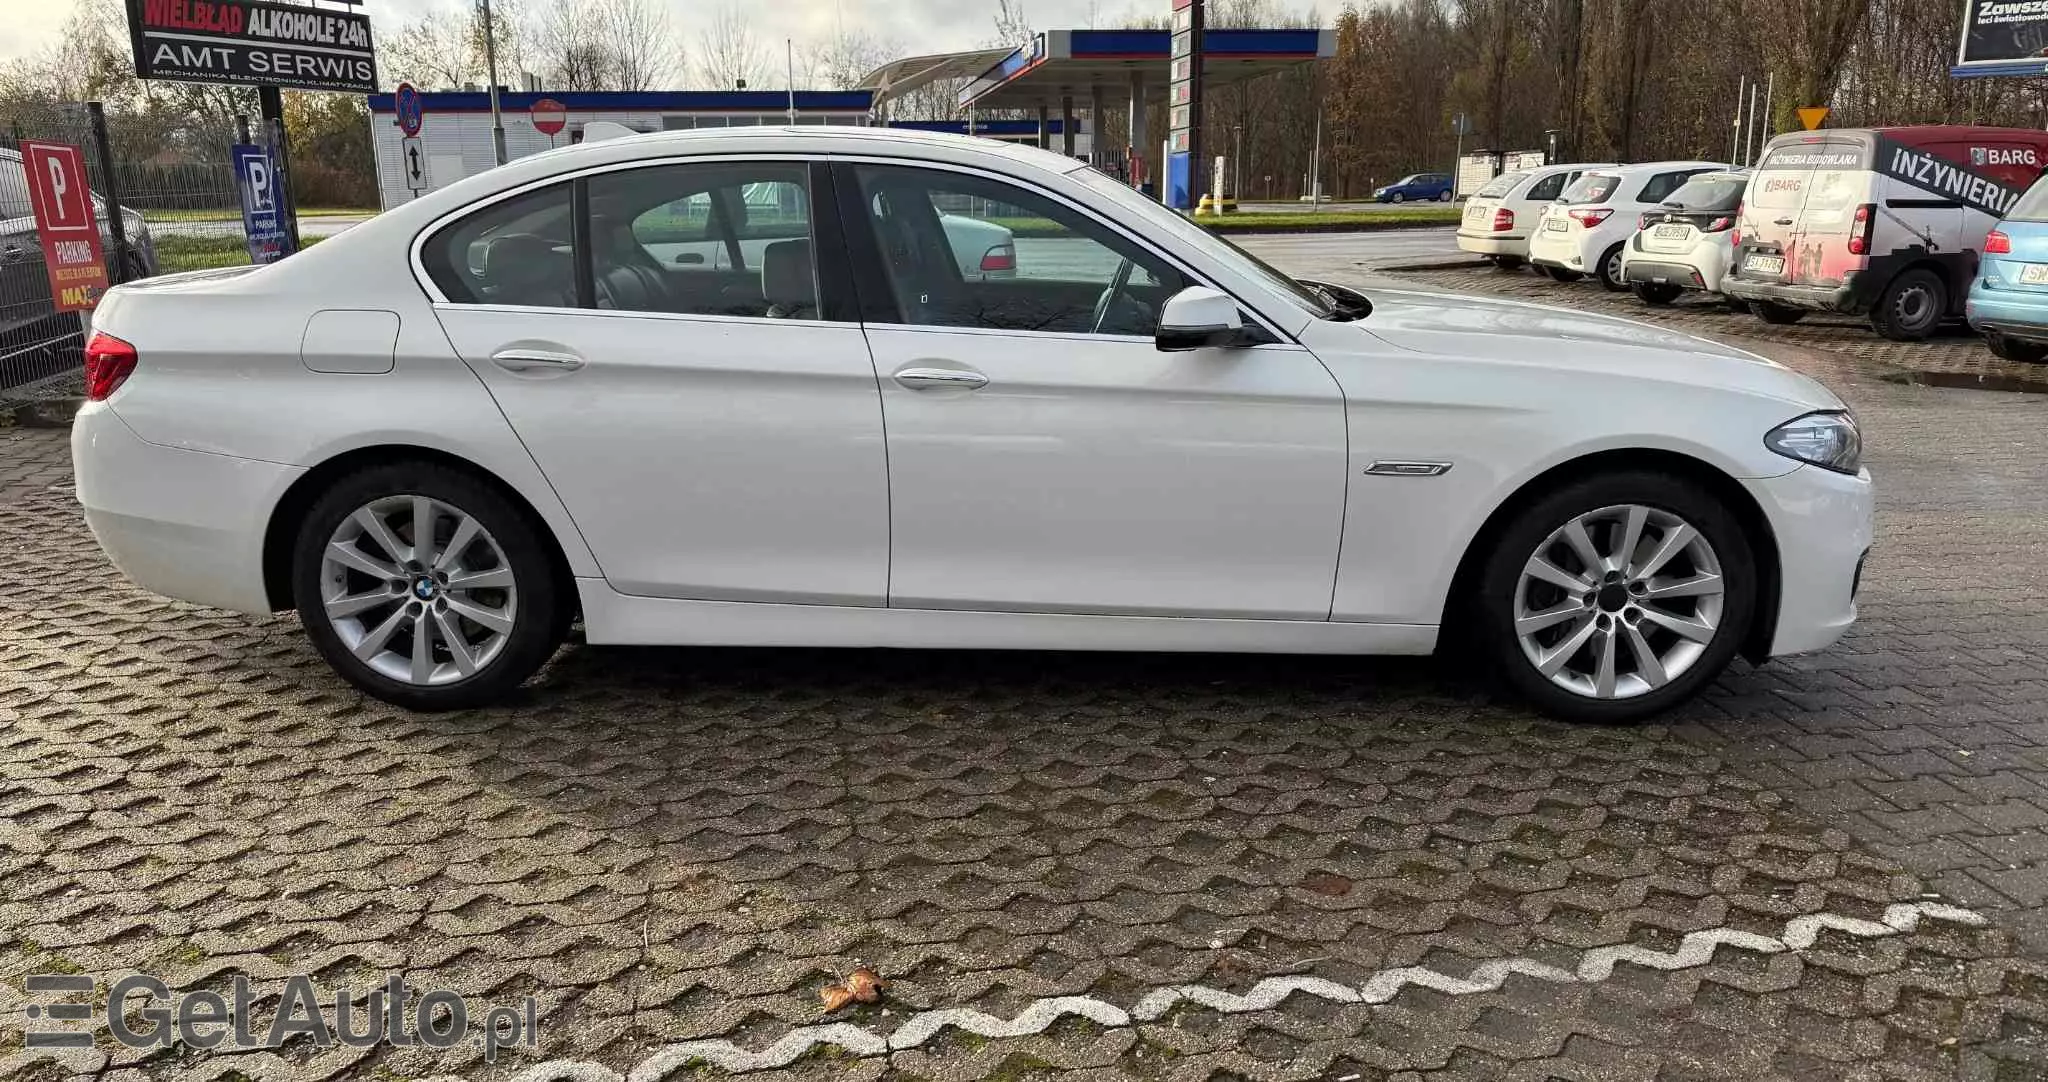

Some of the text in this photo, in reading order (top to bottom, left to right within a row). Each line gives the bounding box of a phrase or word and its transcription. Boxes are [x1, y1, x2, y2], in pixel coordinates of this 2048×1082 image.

[247, 8, 336, 44] ALKOHOLE
[337, 18, 369, 48] 24h
[1994, 13, 2048, 23] światłowod
[152, 43, 372, 81] AMT SERWIS
[152, 69, 228, 80] MECHANIKA
[229, 74, 305, 85] ELEKTRONIKA
[1988, 149, 2036, 165] BARG
[47, 156, 66, 220] P
[249, 162, 267, 208] P
[1774, 178, 1801, 192] BARG
[54, 240, 93, 264] PARKING
